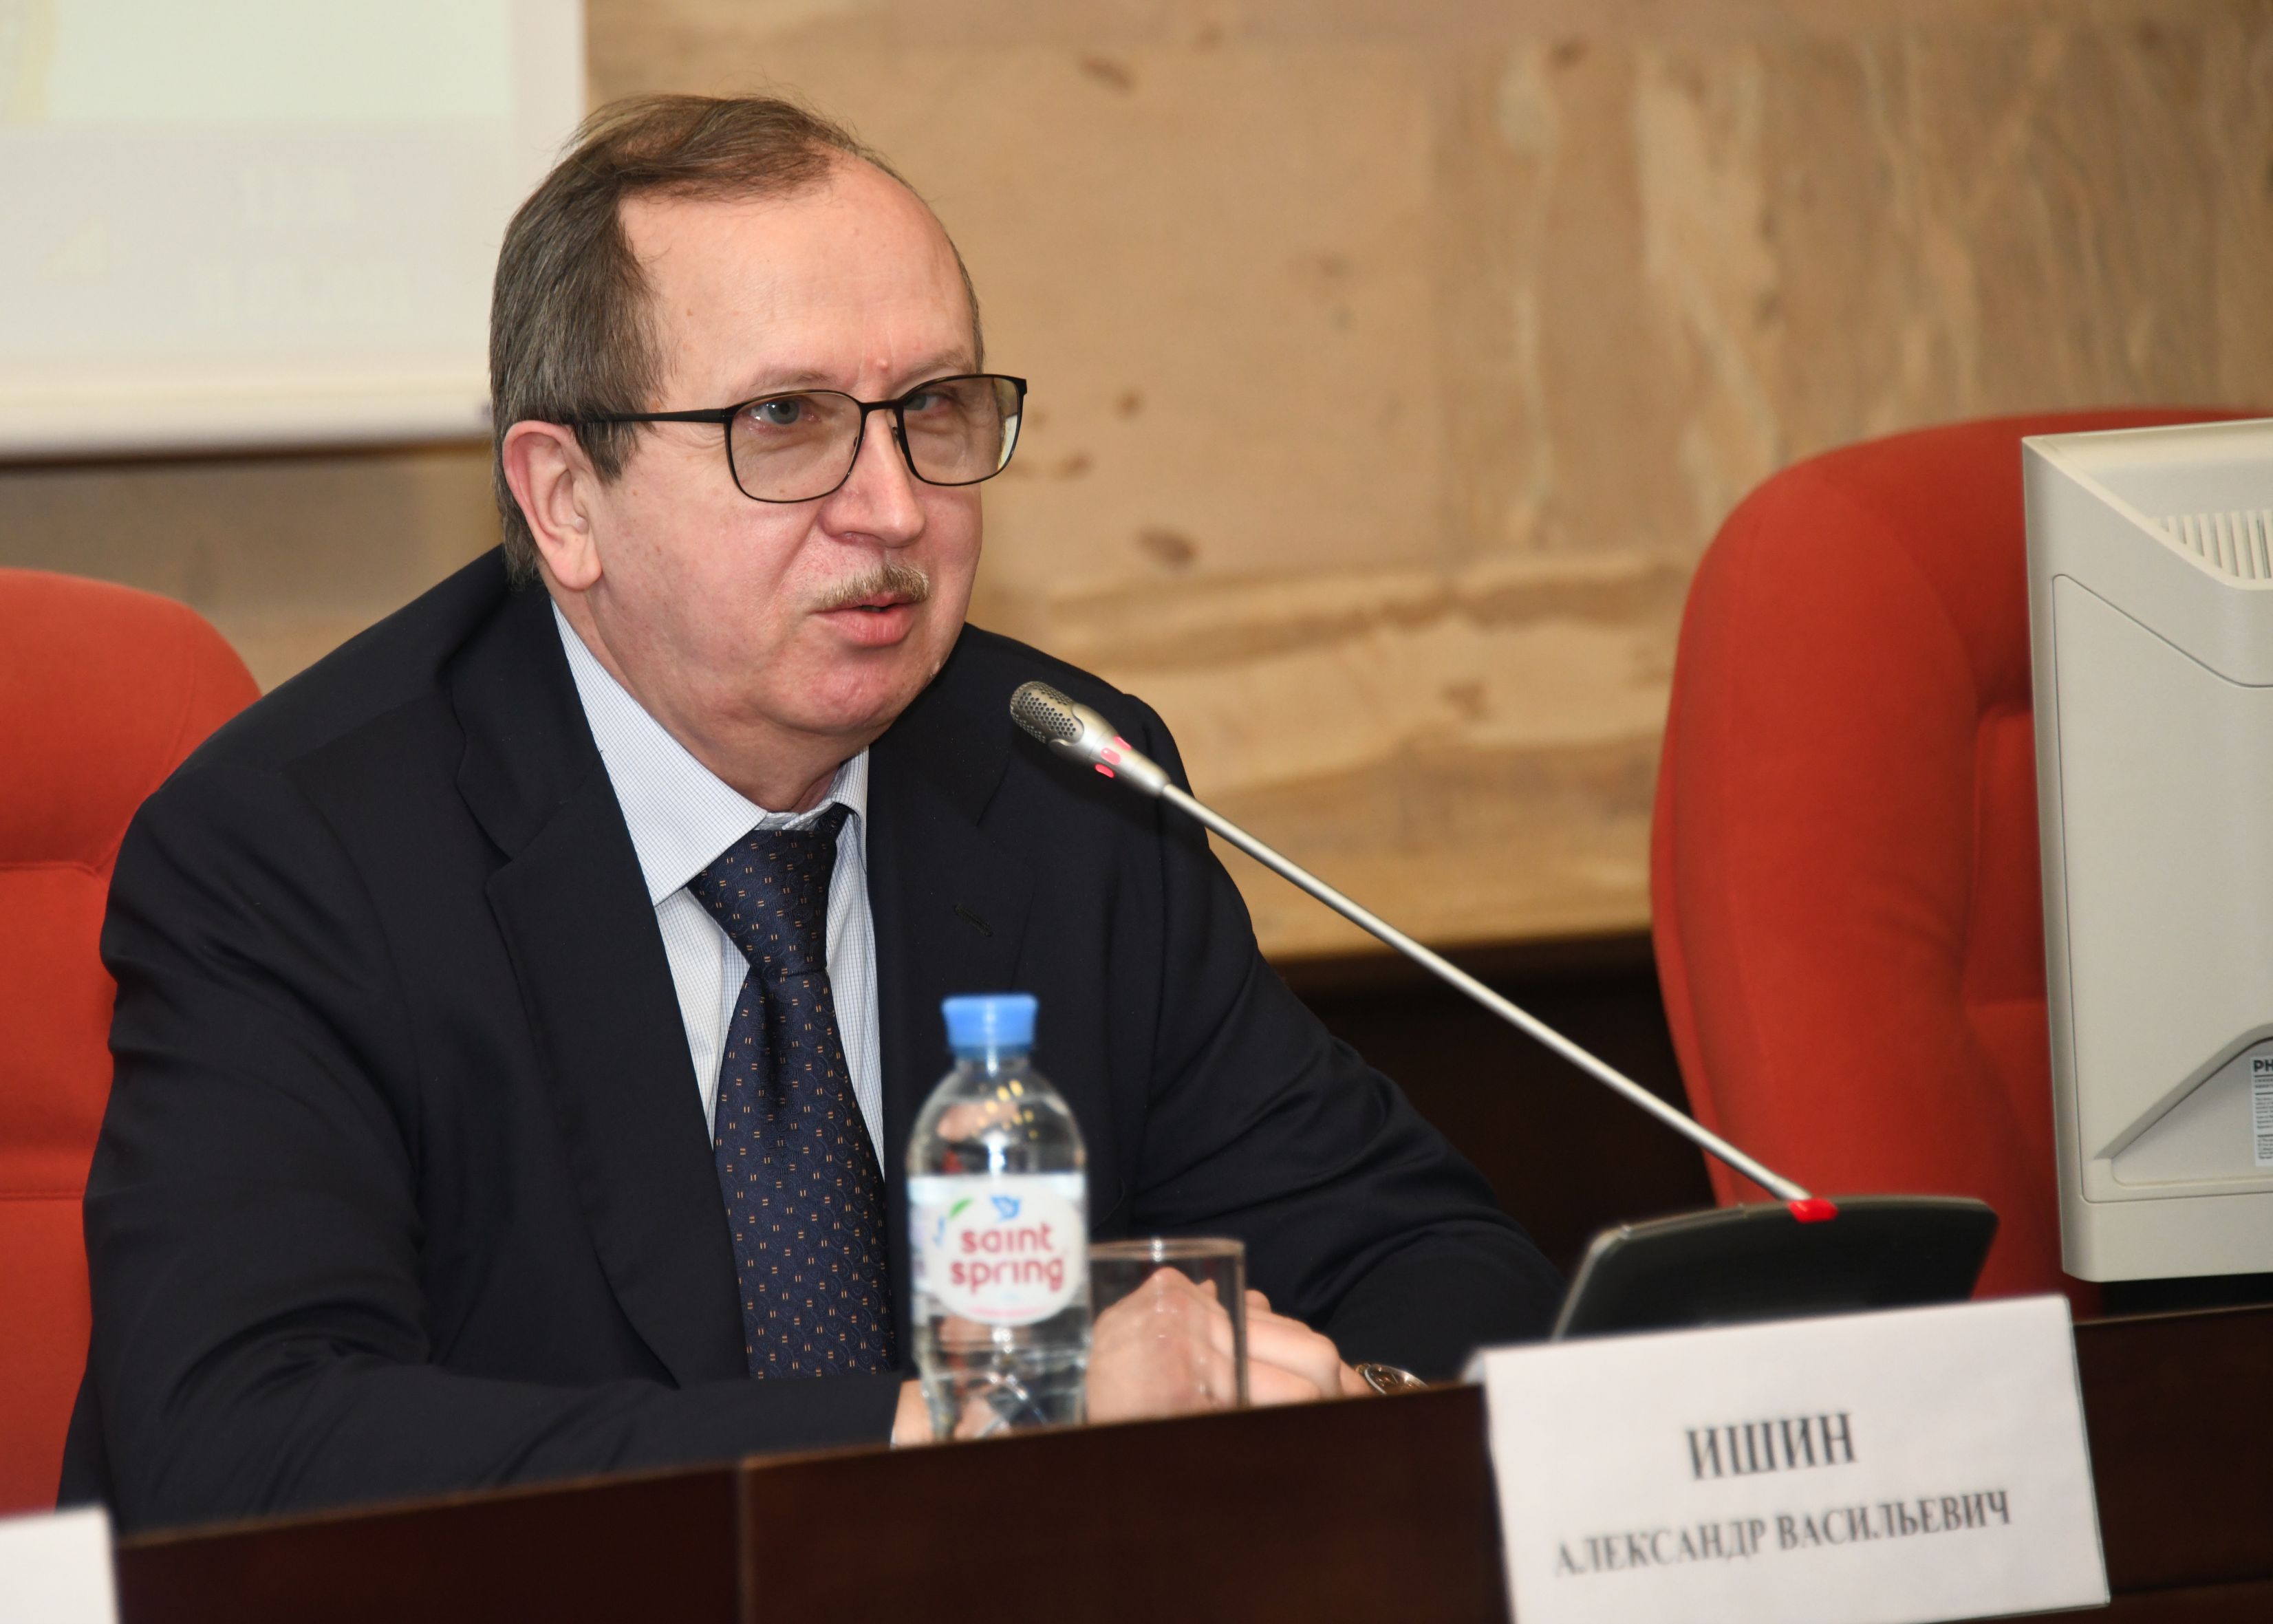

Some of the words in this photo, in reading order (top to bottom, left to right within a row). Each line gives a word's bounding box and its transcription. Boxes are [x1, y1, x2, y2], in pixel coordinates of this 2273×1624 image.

[960, 1222, 1053, 1254] saint
[950, 1257, 1064, 1295] spring
[1685, 1411, 1858, 1480] ИШИН
[1554, 1516, 1767, 1577] АЛЕКСАНДР
[1776, 1489, 2013, 1552] ВАСИЛЬЕВИЧ
